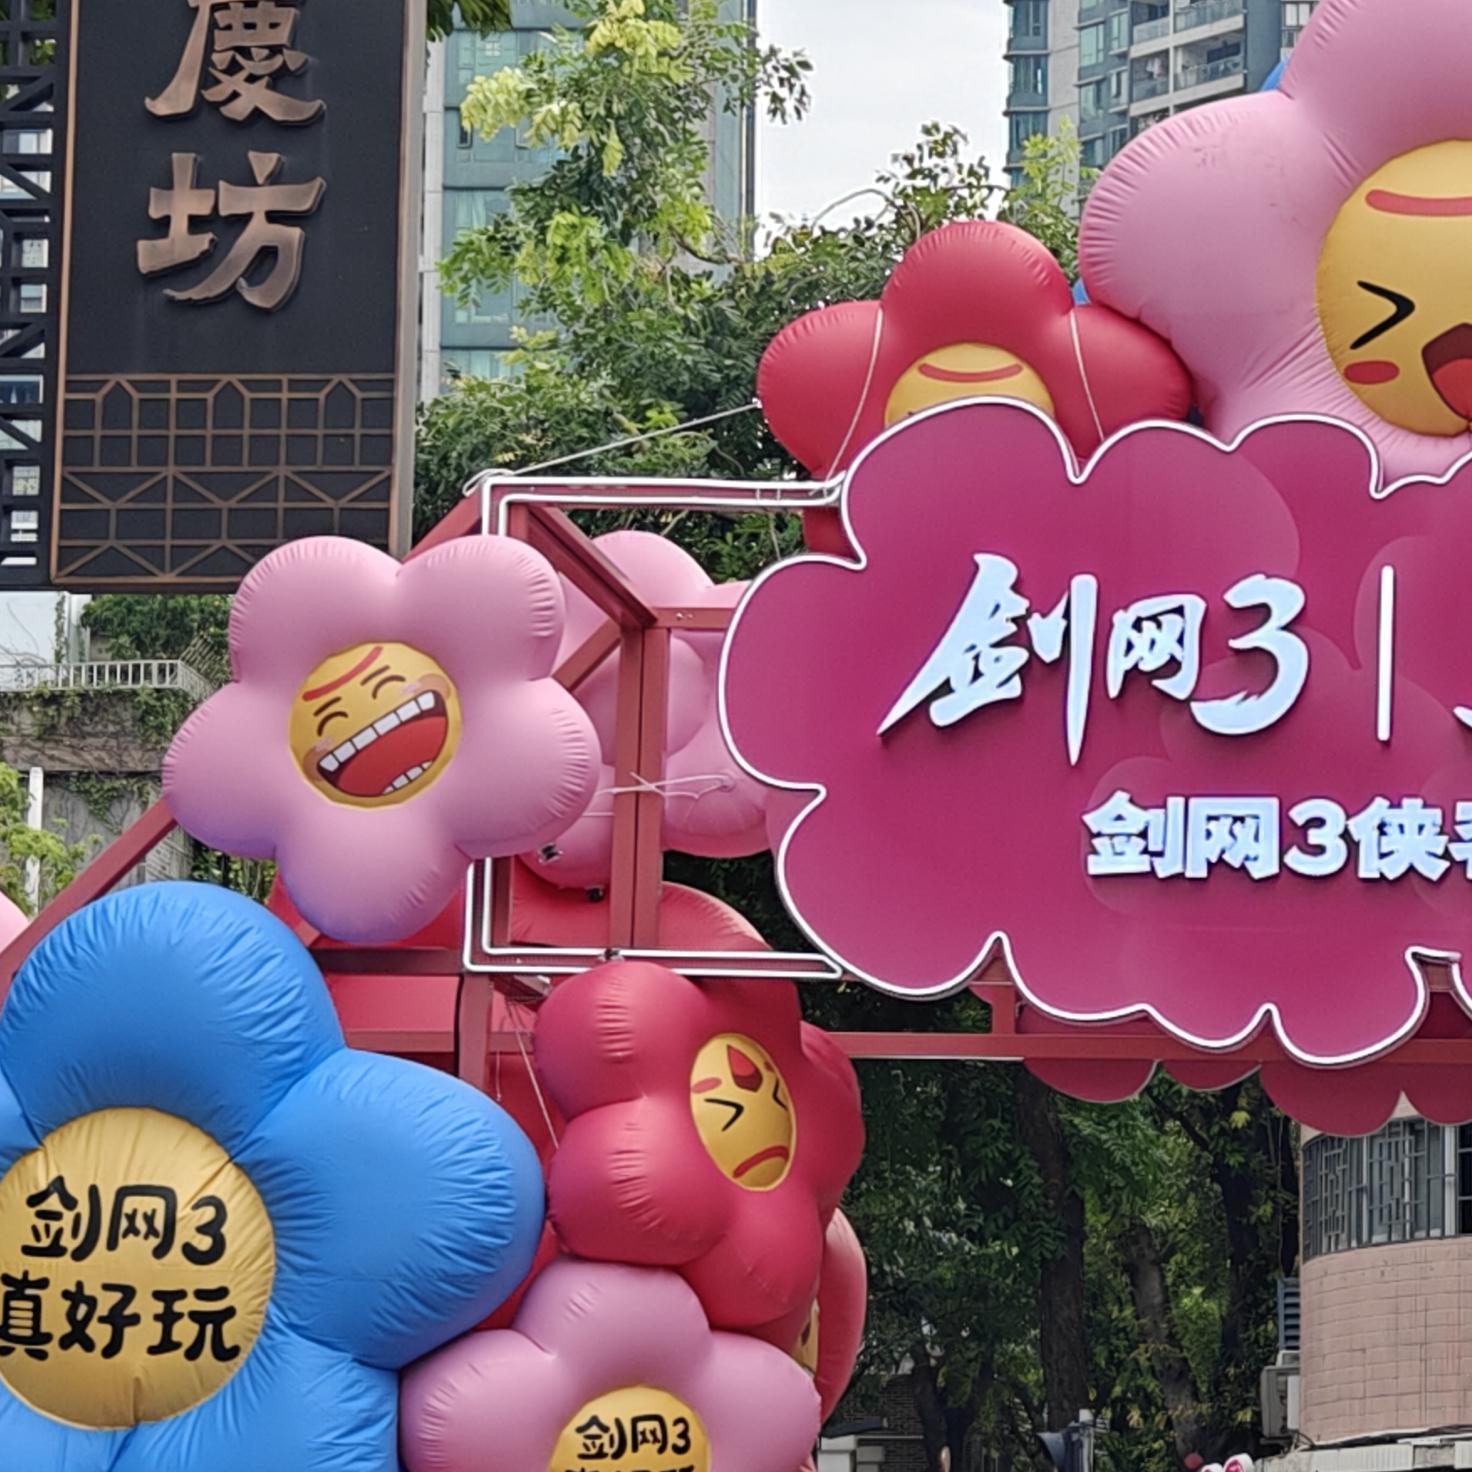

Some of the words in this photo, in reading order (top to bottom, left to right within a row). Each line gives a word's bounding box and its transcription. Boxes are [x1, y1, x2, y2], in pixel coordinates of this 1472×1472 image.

[877, 551, 1310, 766] 剑网3
[22, 1174, 228, 1268] 剑网3
[574, 1413, 694, 1462] 剑网3
